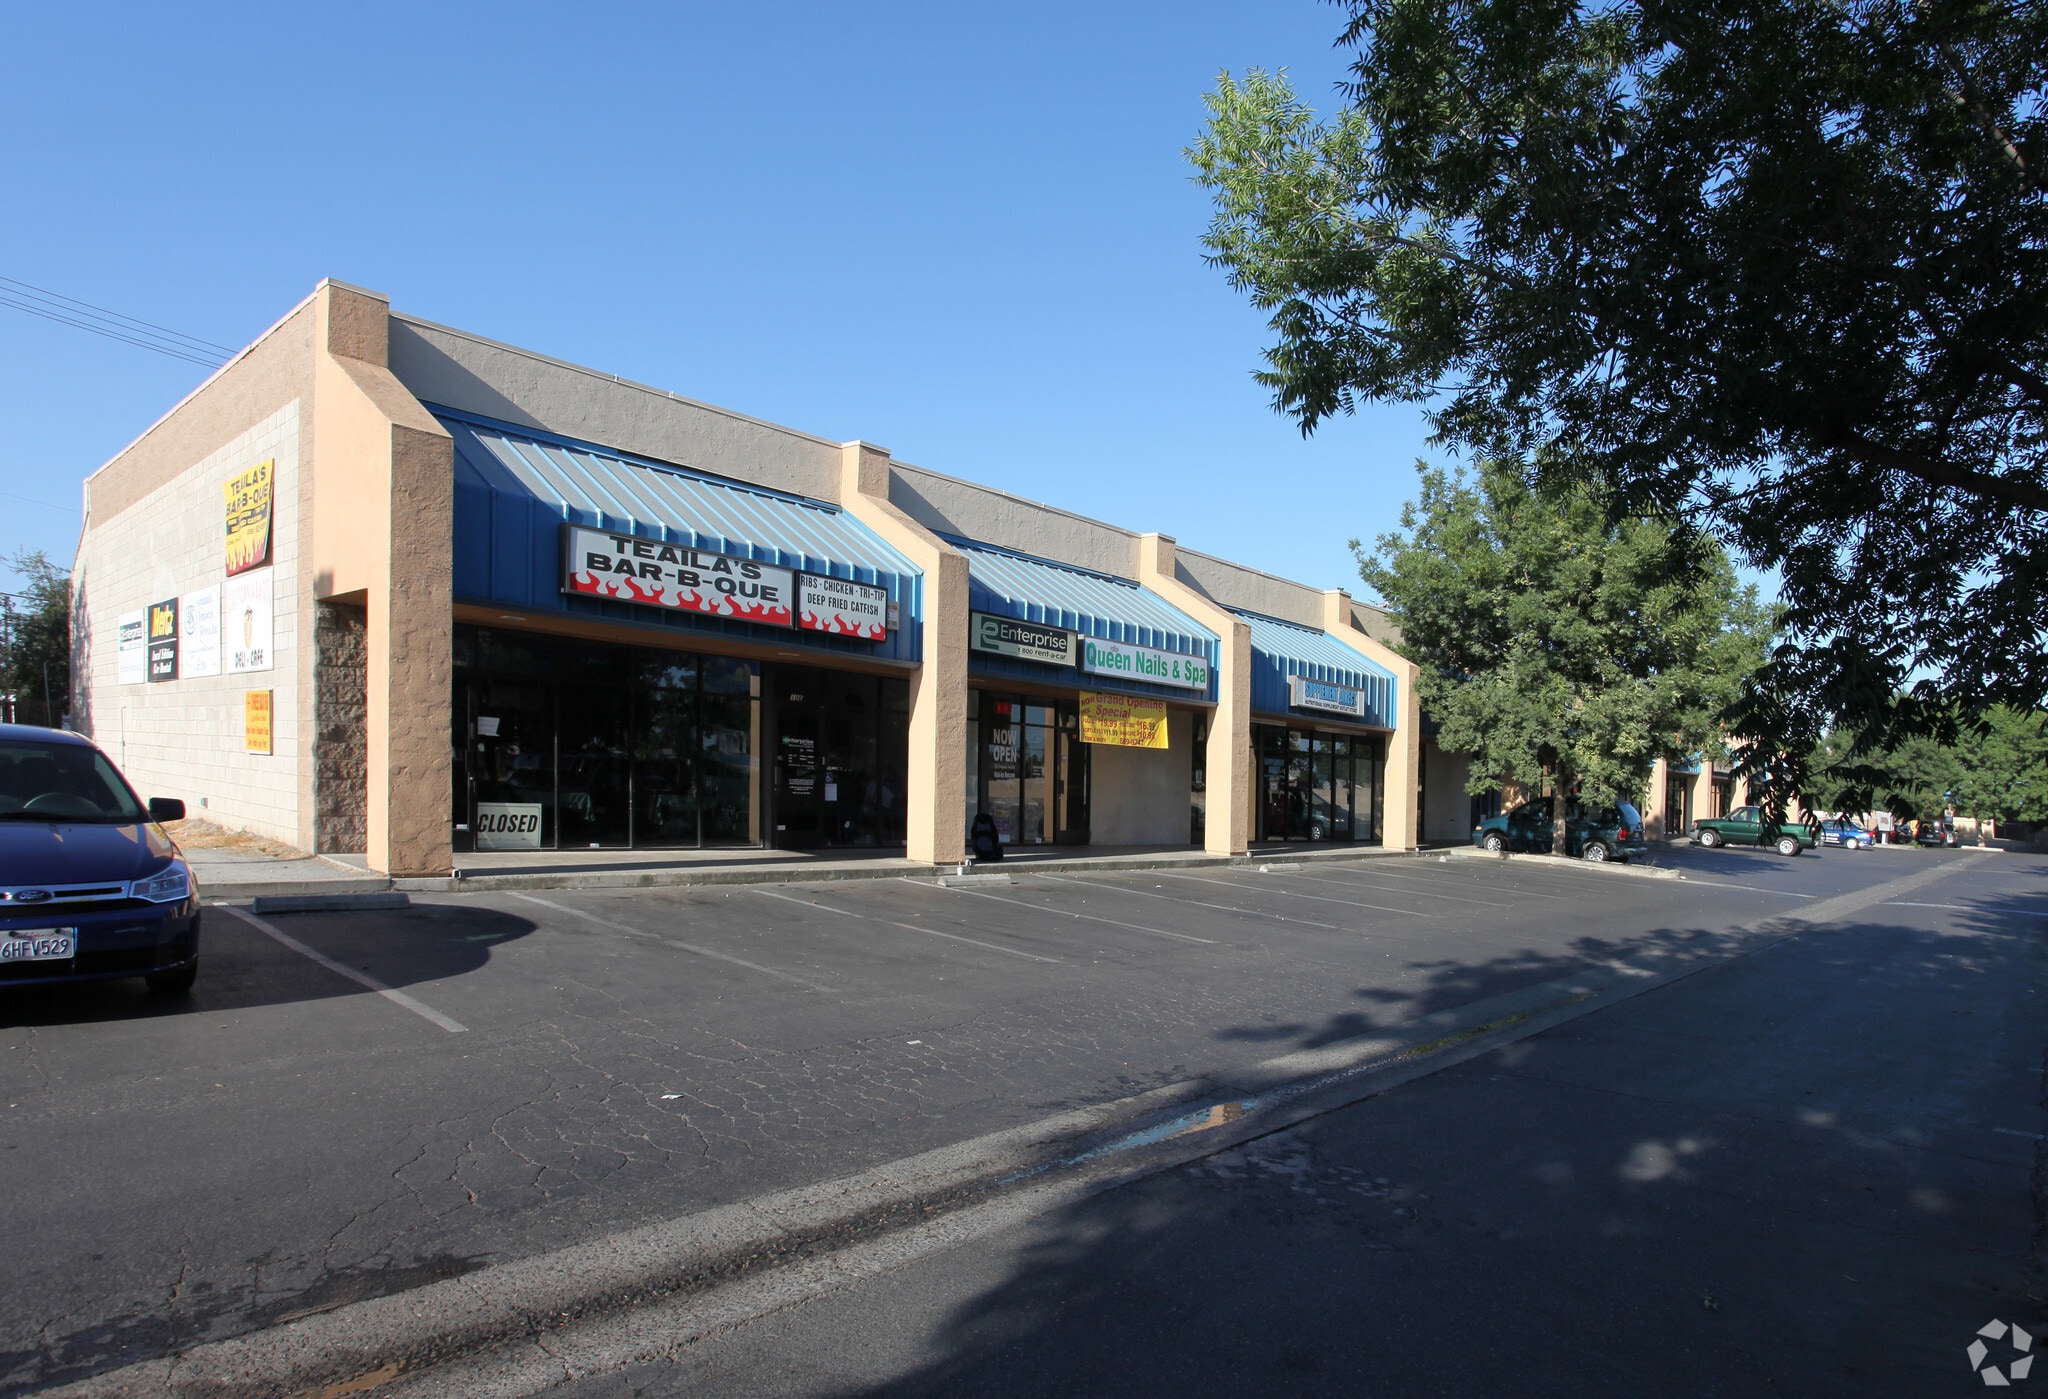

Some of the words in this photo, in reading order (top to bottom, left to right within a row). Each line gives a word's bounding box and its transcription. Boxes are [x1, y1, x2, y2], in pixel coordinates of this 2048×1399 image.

[609, 535, 762, 580] TEAILA'S
[586, 552, 779, 603] BAR-B-QUE
[800, 575, 818, 589] RIBS
[824, 580, 854, 596] CHICKEN
[859, 587, 885, 602] TRI-TIP
[807, 593, 826, 606] DEEP
[828, 597, 848, 610] FRIED
[850, 601, 879, 616] CATFISH
[152, 604, 174, 637] Hertz
[1000, 624, 1067, 650] Enterprise
[1035, 650, 1066, 660] rent-a-car
[1086, 642, 1131, 672] Queen
[1135, 651, 1168, 678] Nails
[1172, 660, 1180, 679] &
[1184, 660, 1206, 687] Spa
[1096, 692, 1125, 705] Grand
[1127, 696, 1164, 713] Opening
[1096, 704, 1131, 718] Special
[993, 728, 1017, 745] NOW
[993, 745, 1017, 762] OPEN
[478, 813, 538, 832] CLOSED
[1, 938, 68, 958] 6HFV529
